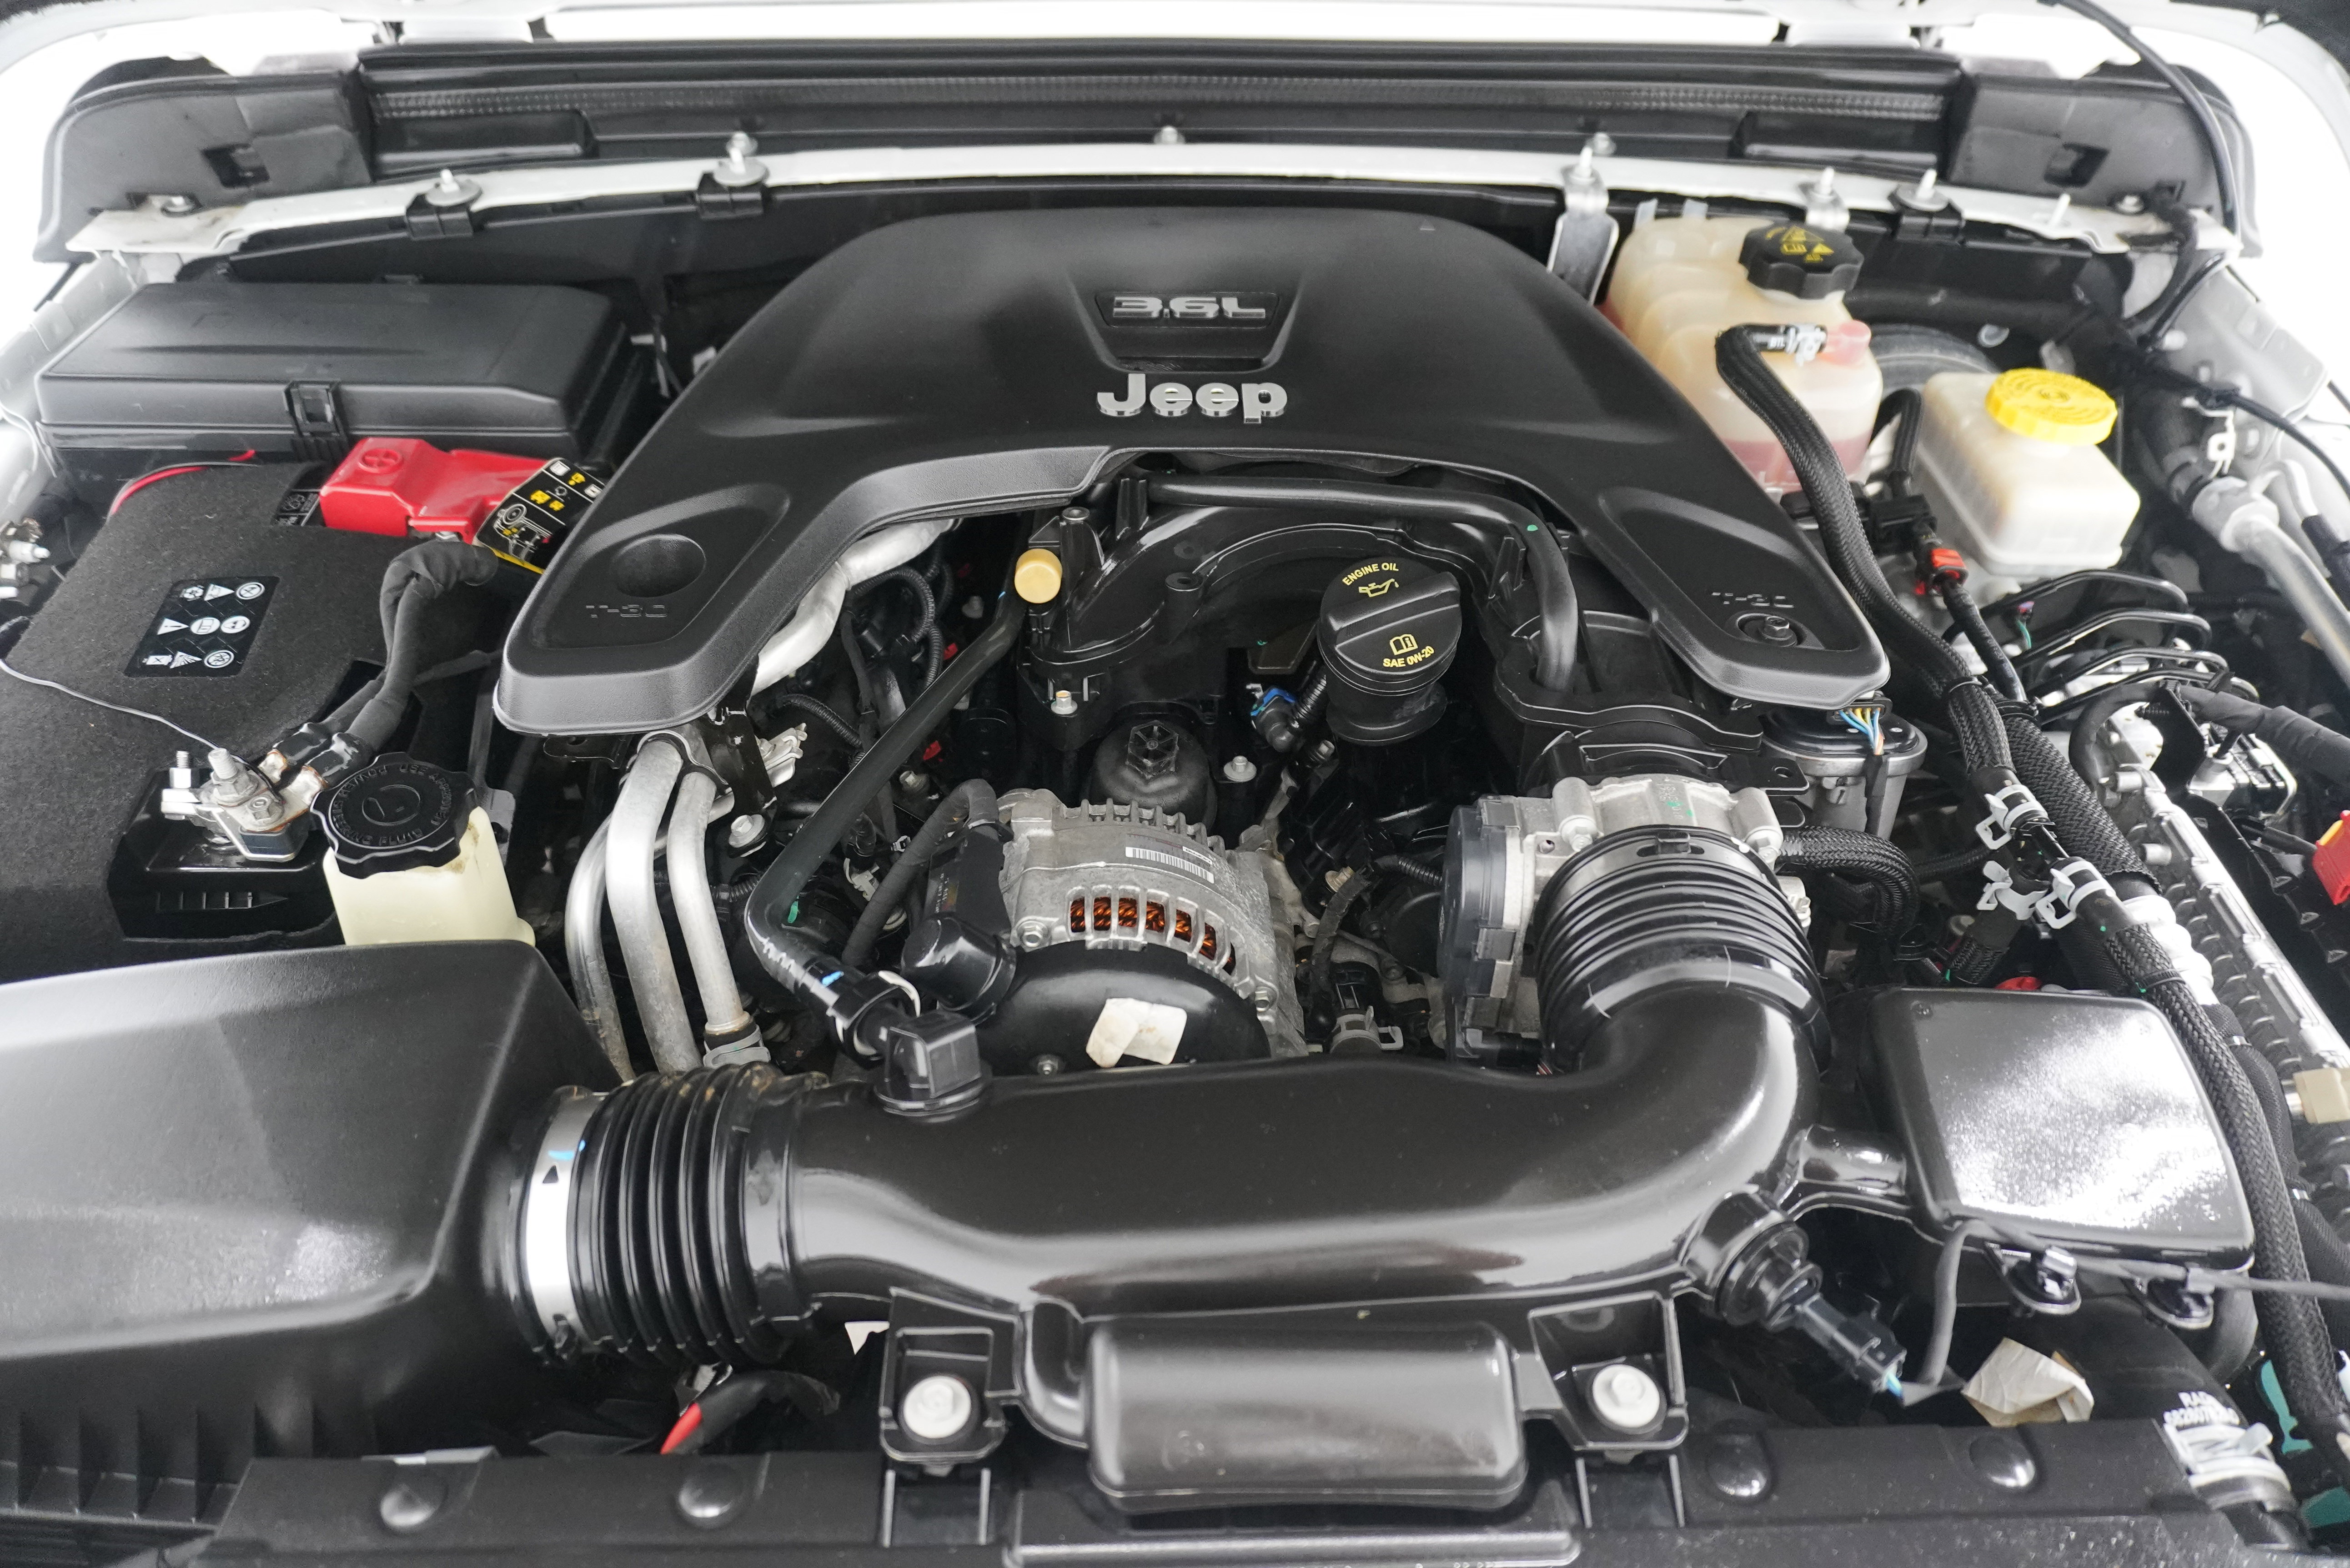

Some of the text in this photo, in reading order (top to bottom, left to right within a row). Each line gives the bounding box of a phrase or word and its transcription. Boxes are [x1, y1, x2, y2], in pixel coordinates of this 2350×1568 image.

[1113, 296, 1265, 318] 3.6L
[1096, 373, 1288, 424] Jeep
[1342, 563, 1399, 586] ENGINE OIL
[586, 605, 668, 618] T-30
[1383, 646, 1434, 667] SAE 0W-20
